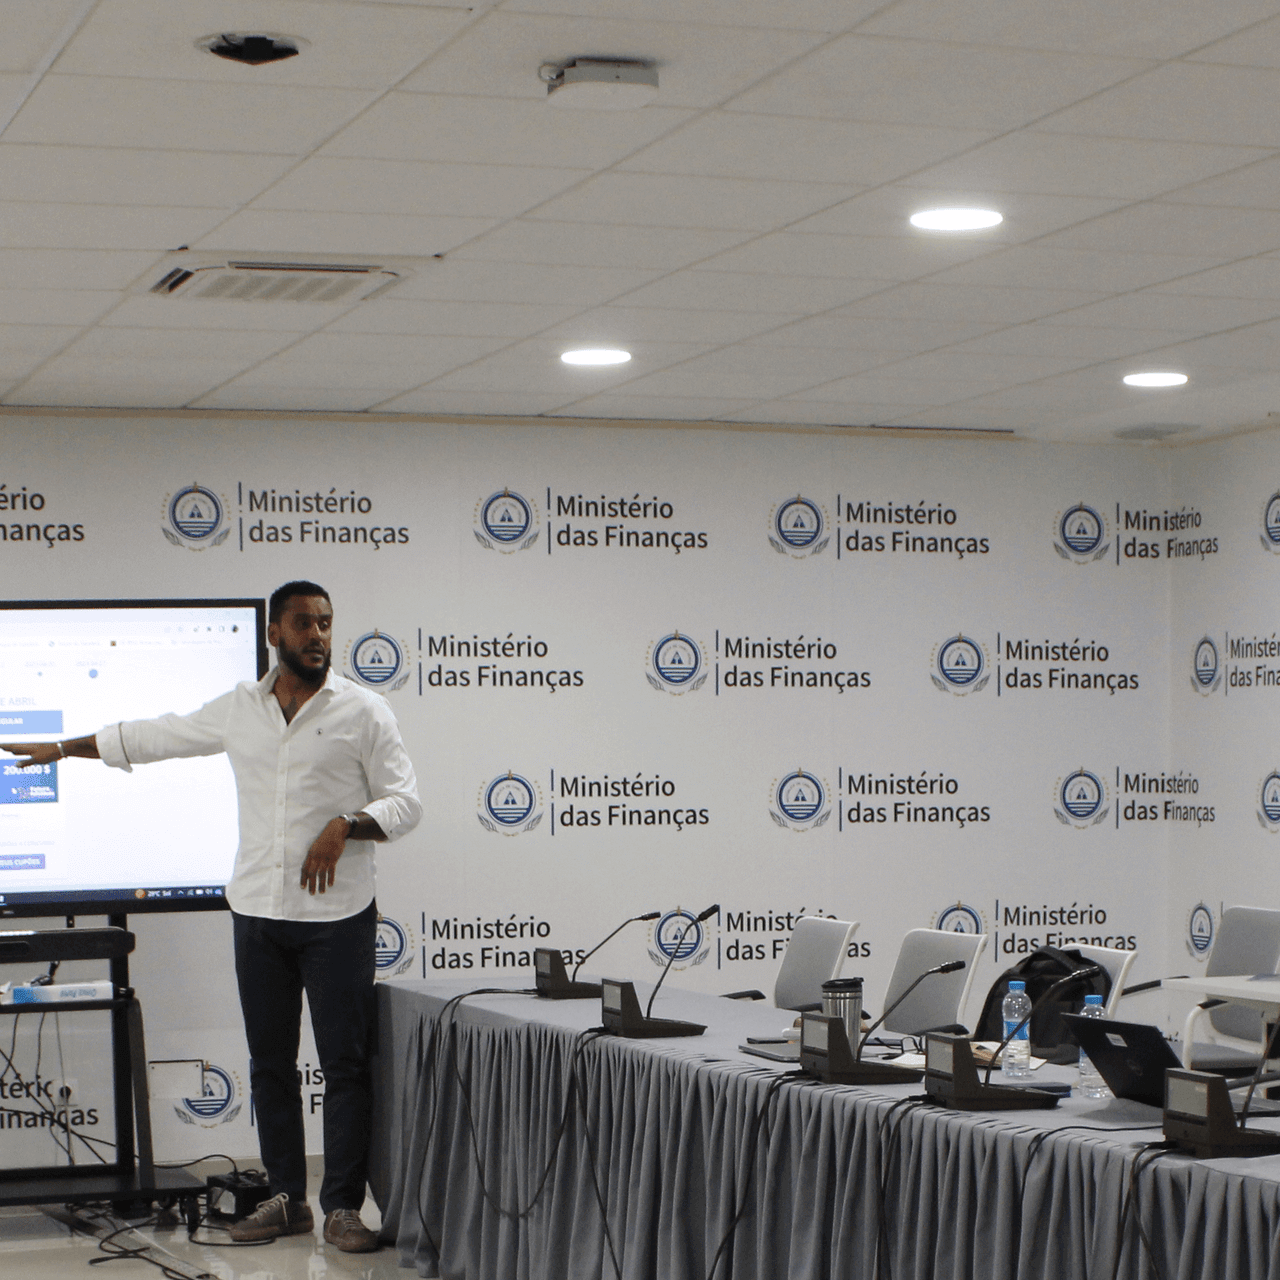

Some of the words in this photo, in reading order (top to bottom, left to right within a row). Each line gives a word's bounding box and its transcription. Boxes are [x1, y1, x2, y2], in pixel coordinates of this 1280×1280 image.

[249, 488, 372, 513] Ministério
[557, 494, 673, 519] Ministério
[847, 501, 957, 525] Ministério
[1124, 505, 1202, 531] Ministério
[249, 519, 292, 542] das
[300, 520, 409, 550] Finanças
[557, 524, 598, 546] das
[606, 524, 708, 554] Finanças
[846, 530, 885, 552] das
[892, 531, 989, 559] Finanças
[1124, 537, 1160, 558] das
[1166, 537, 1219, 561] Finanças
[429, 633, 548, 657] Ministério
[725, 635, 837, 659] Ministério
[1006, 638, 1109, 662] Ministério
[428, 664, 470, 687] das
[478, 665, 583, 693] Finanças
[724, 665, 763, 687] das
[771, 666, 871, 693] Finanças
[1006, 667, 1042, 688] das
[1049, 668, 1139, 695] Finanças
[1230, 666, 1252, 687] das
[561, 773, 675, 797] Ministério
[848, 771, 958, 794] Ministério
[1124, 770, 1199, 794] Ministério
[560, 805, 601, 826] das
[609, 804, 709, 831] Finanças
[848, 802, 886, 823] das
[894, 801, 990, 828] Finanças
[1123, 799, 1158, 821] das
[1164, 802, 1215, 828] Finanças
[1004, 902, 1106, 926] Ministério
[432, 914, 550, 940] Ministério
[726, 938, 766, 961] das
[1003, 933, 1039, 953] das
[432, 947, 473, 969] das
